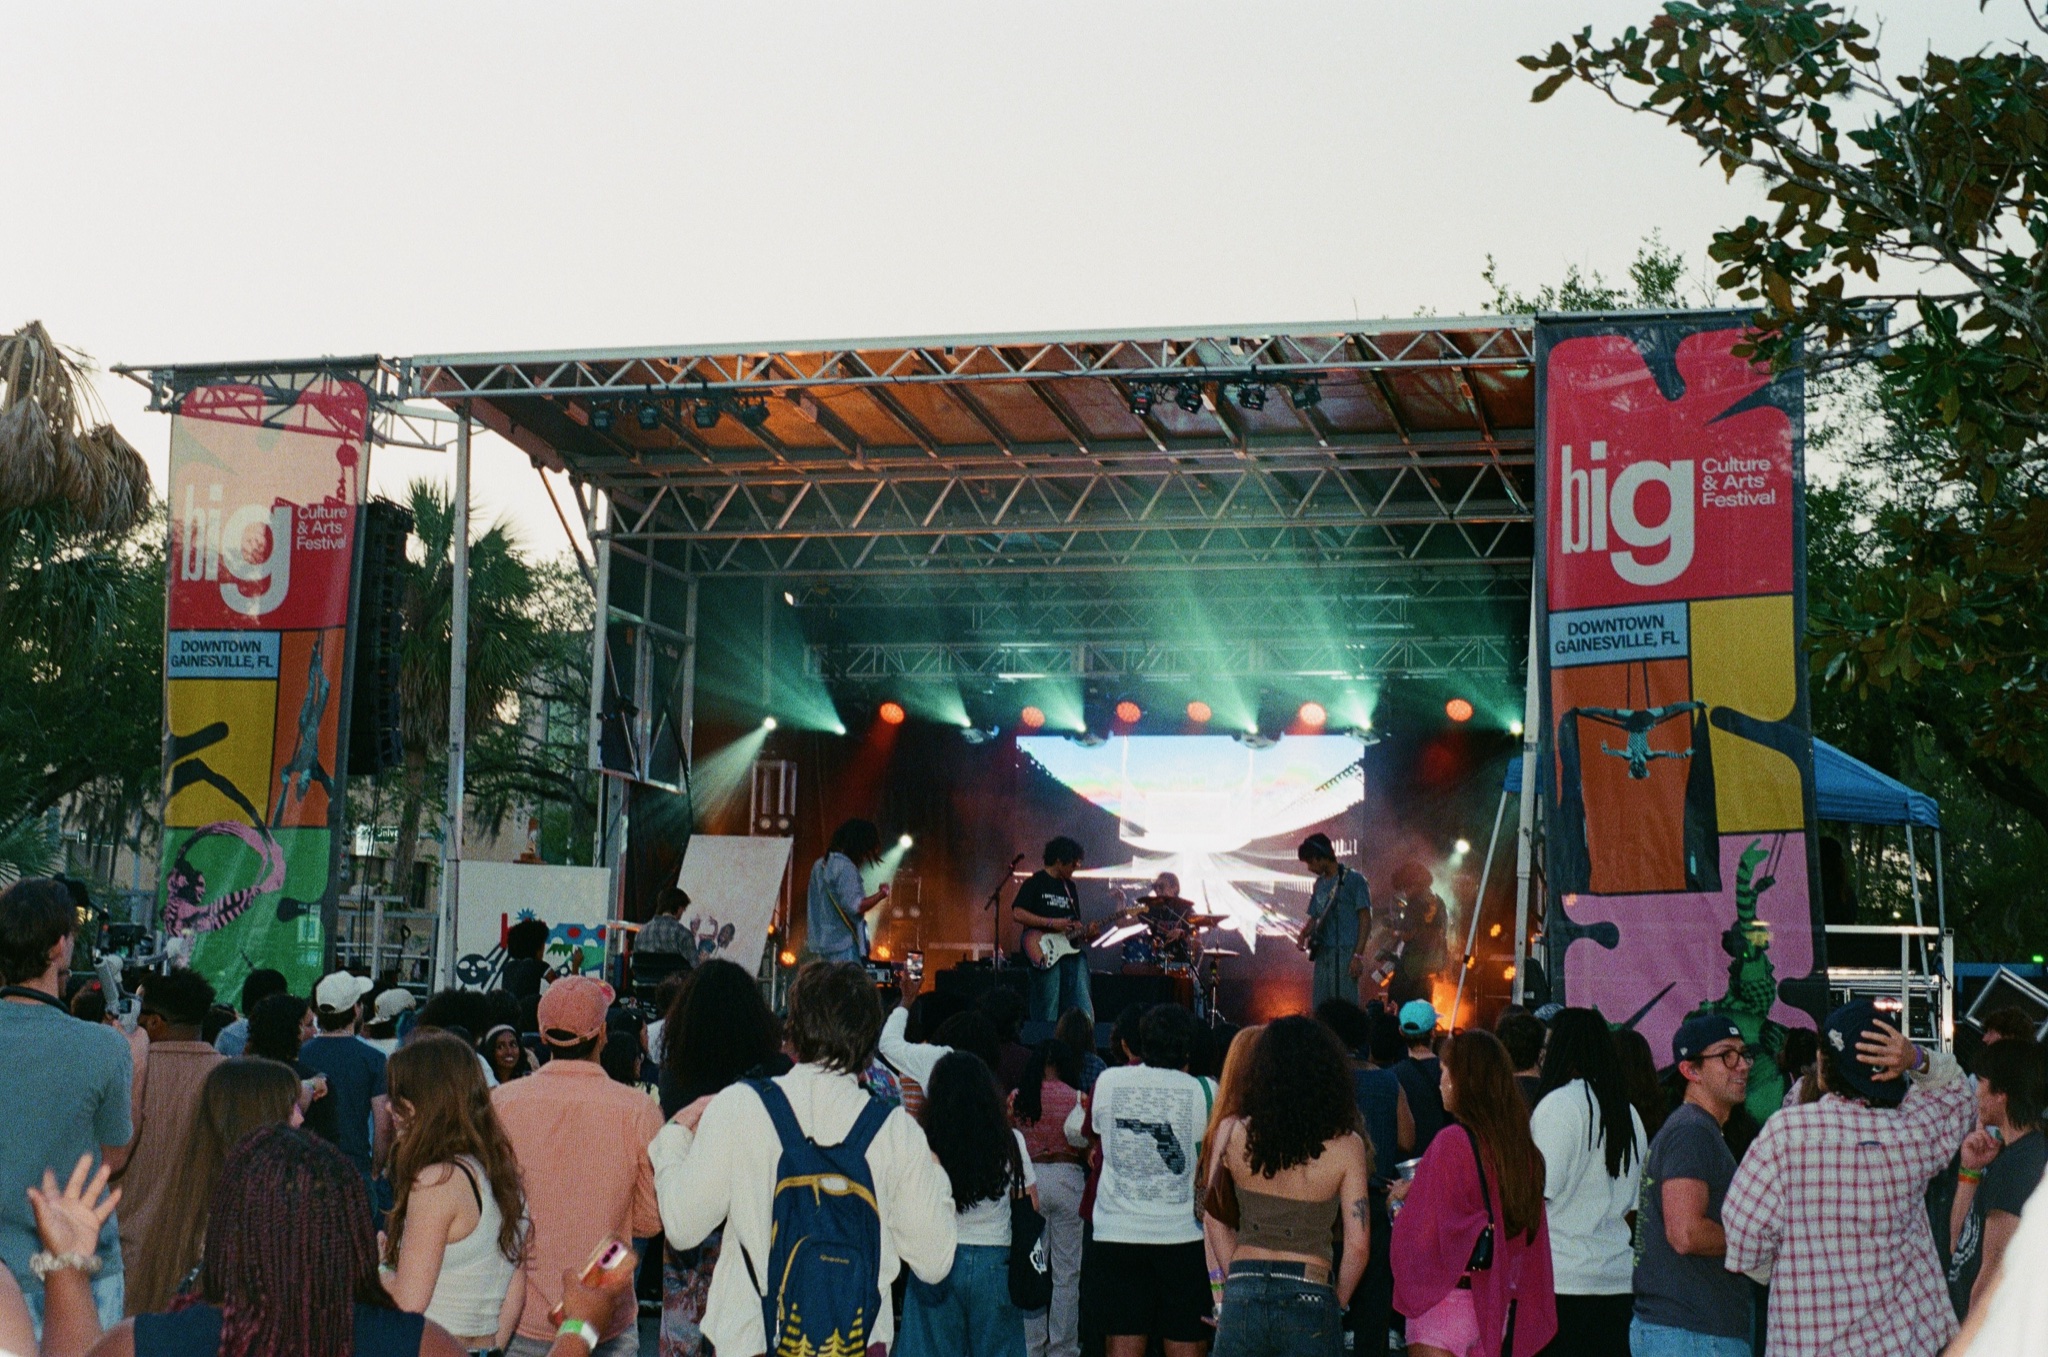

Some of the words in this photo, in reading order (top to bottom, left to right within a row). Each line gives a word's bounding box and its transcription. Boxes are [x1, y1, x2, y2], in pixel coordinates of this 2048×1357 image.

[1701, 456, 1771, 474] Culture
[1702, 475, 1718, 491] &
[1723, 474, 1765, 490] Arts
[1702, 488, 1776, 508] Festival
[297, 505, 348, 519] Culture
[1561, 440, 1695, 586] big
[297, 520, 308, 535] &
[311, 520, 342, 534] Arts
[181, 484, 293, 616] big
[296, 535, 347, 550] Festival
[1567, 615, 1664, 635] DOWNTOWN
[181, 640, 261, 653] DOWNTOWN
[1555, 632, 1658, 654] GAINESVILLE,
[1661, 631, 1680, 645] FL
[171, 655, 254, 670] GAINESVILLE,
[258, 655, 273, 668] FL
